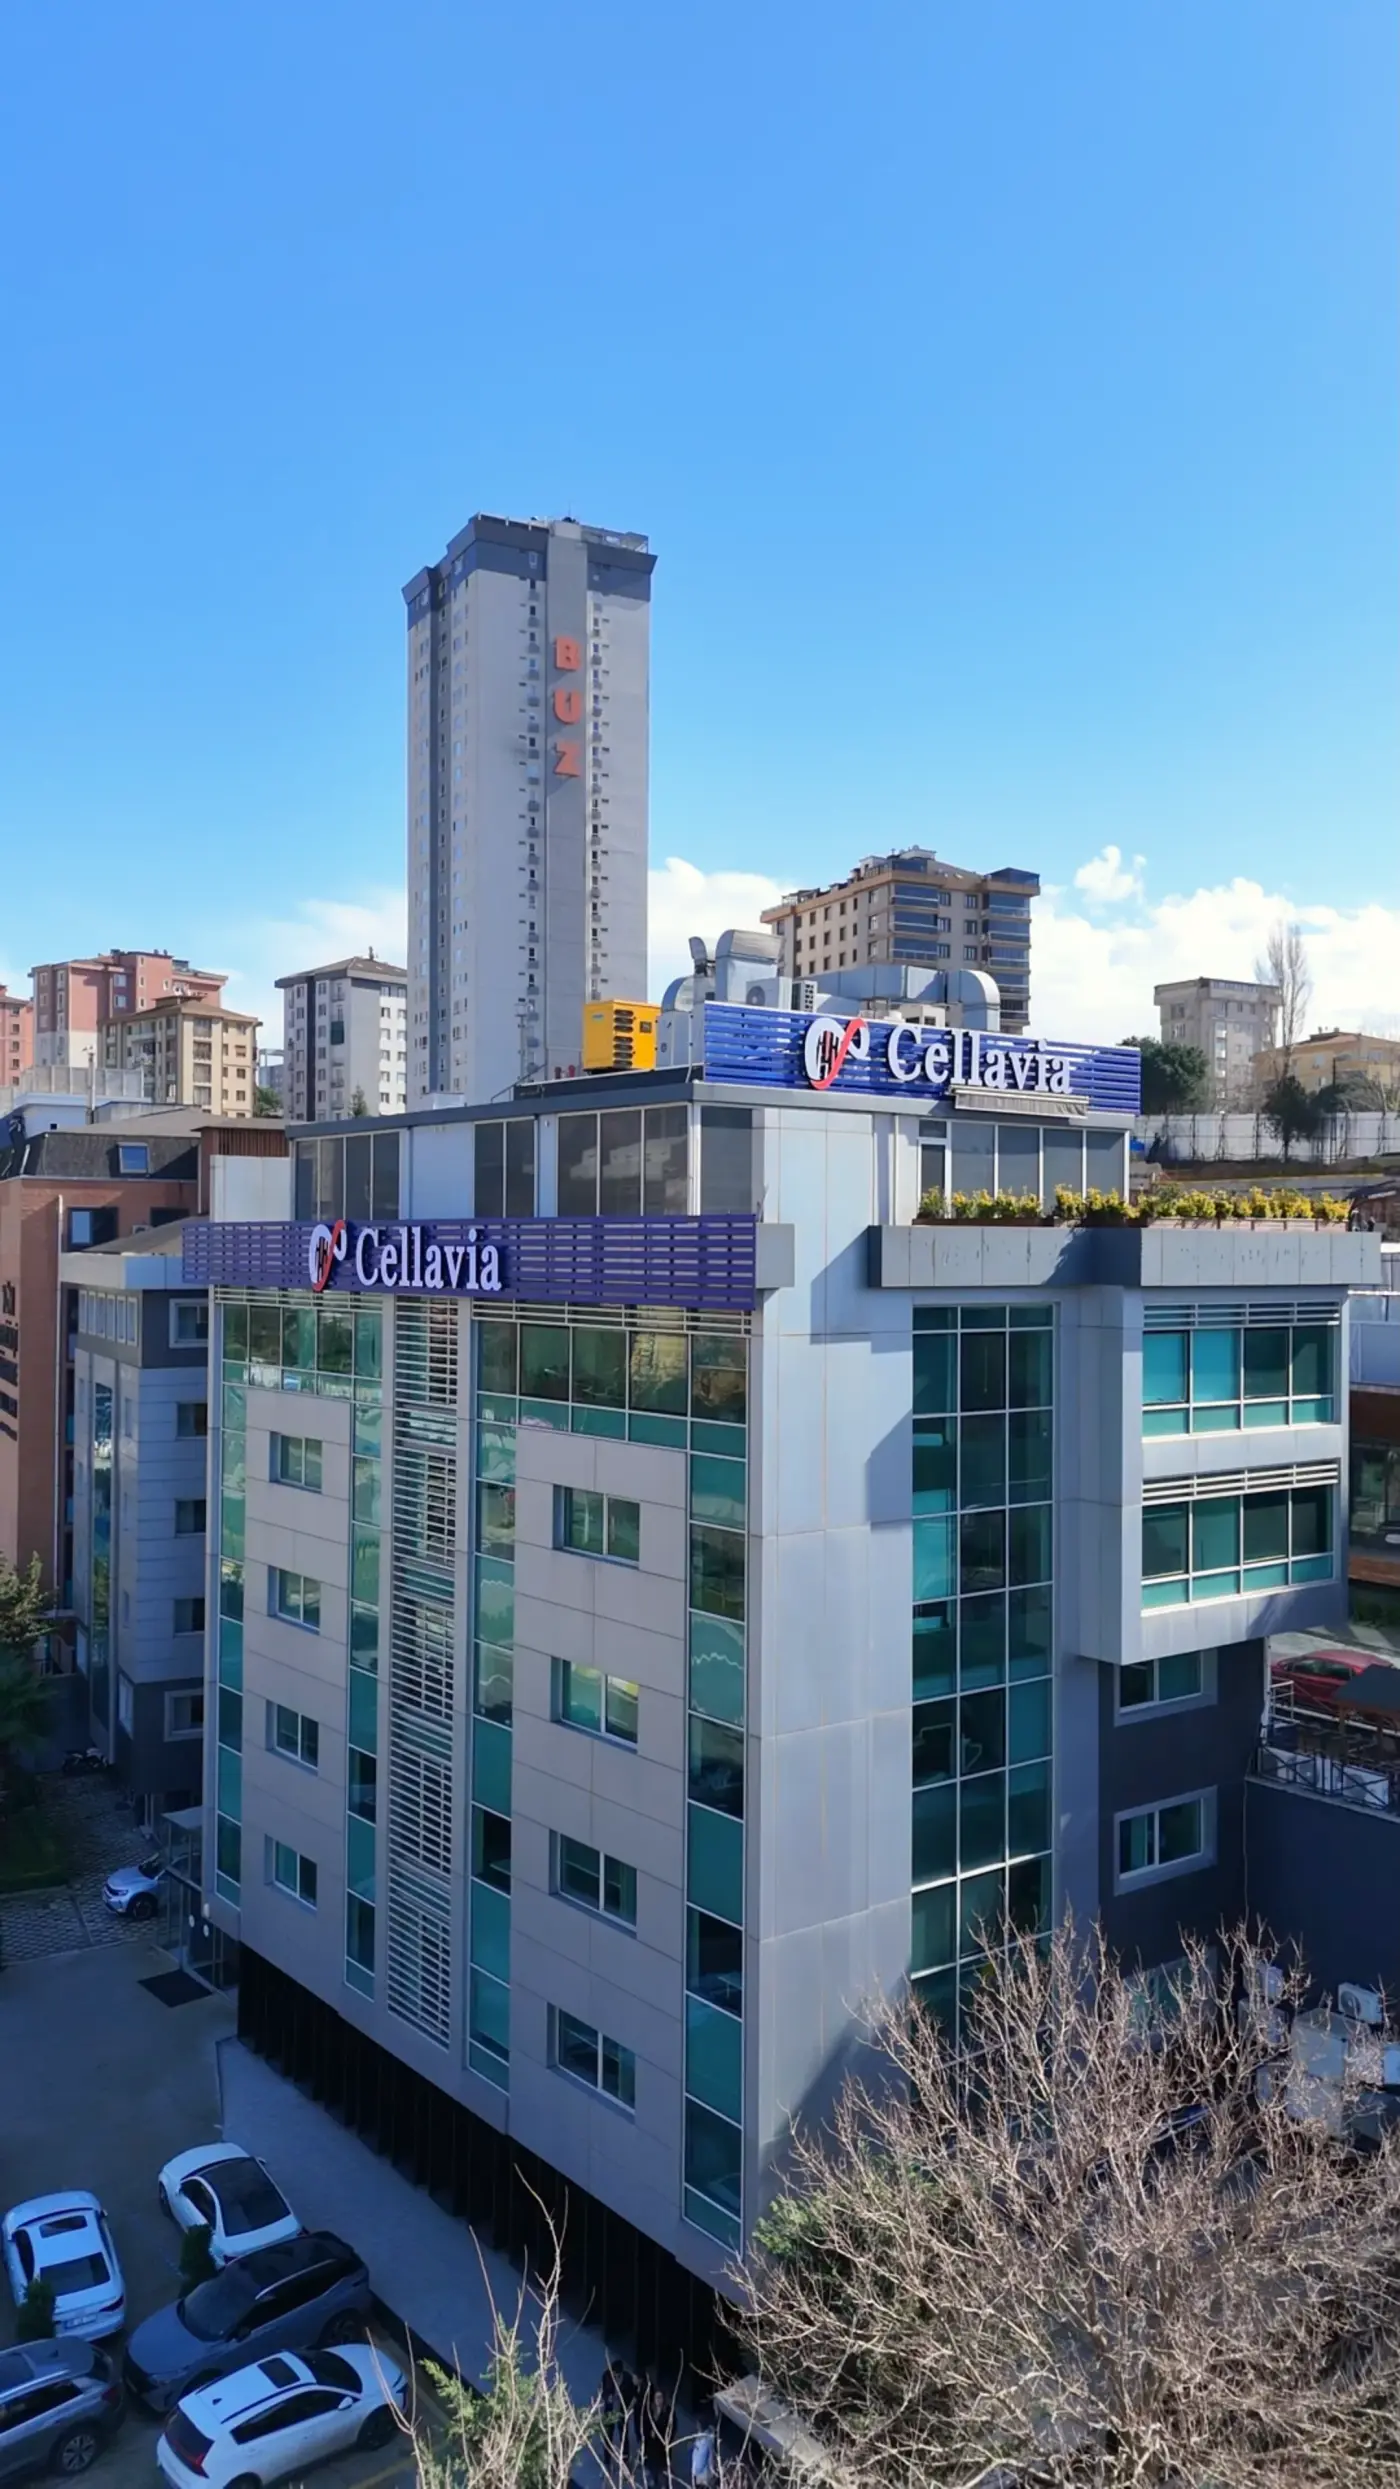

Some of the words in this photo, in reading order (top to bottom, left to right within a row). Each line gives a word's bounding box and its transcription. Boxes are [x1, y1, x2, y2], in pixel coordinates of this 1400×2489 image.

[553, 635, 582, 778] BUZ
[887, 1025, 1072, 1094] Cellavia
[355, 1226, 502, 1291] Cellavia
